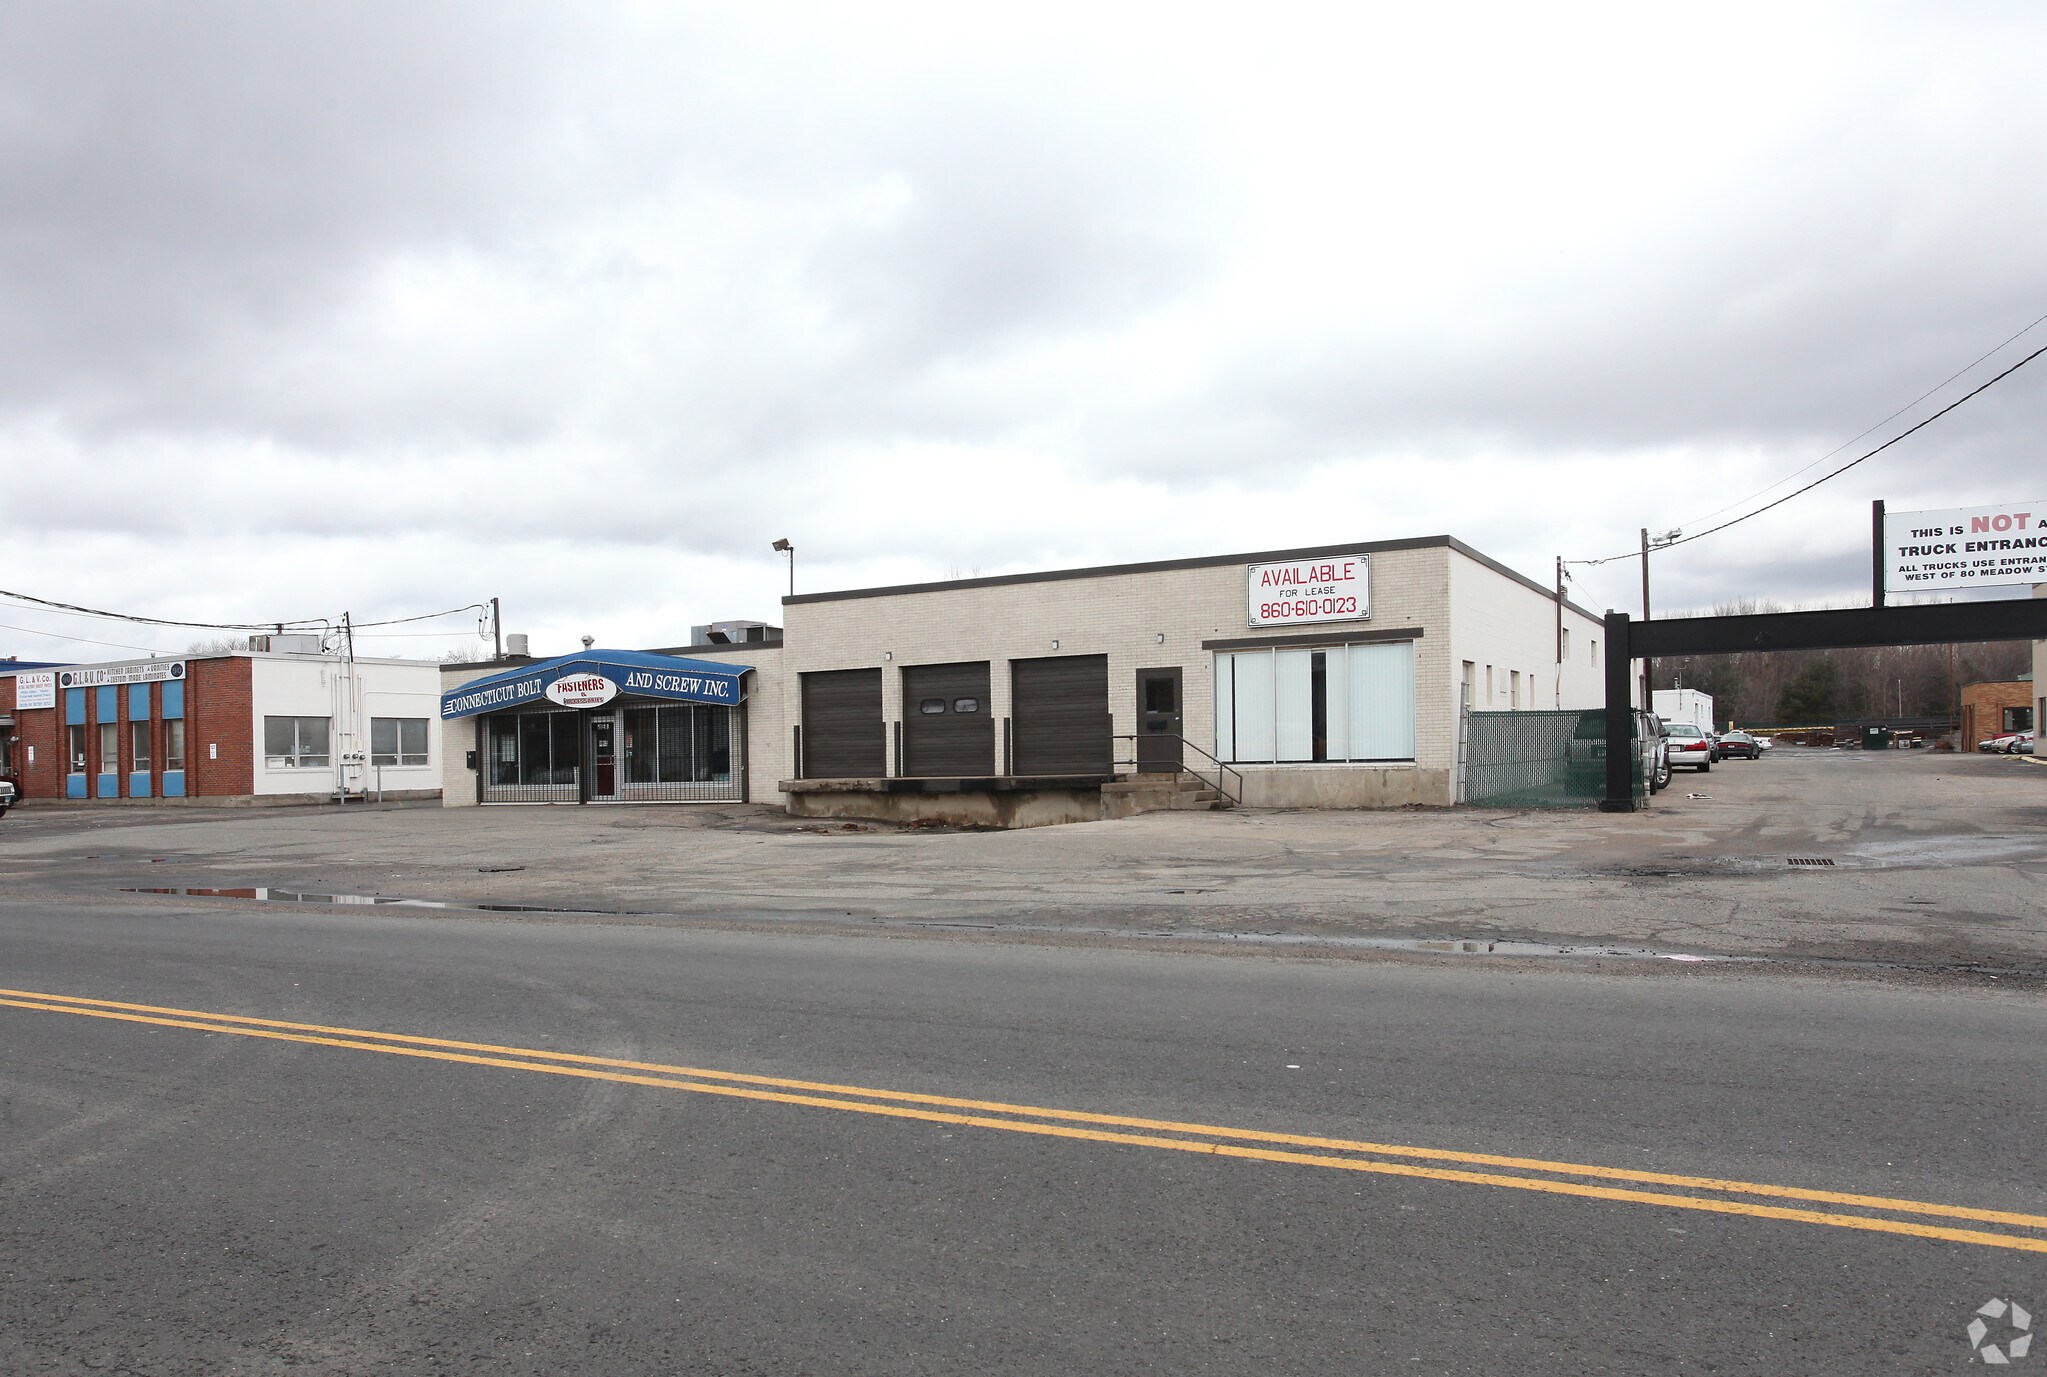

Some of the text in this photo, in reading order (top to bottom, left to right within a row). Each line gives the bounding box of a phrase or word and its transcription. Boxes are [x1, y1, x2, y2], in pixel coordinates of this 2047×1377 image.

[1910, 512, 2047, 538] THIS IS NOT A
[1898, 543, 1957, 557] TRUCK
[1898, 556, 2047, 573] ALL TRUCKS USE ENTRAN
[1260, 562, 1356, 588] AVAILABLE
[1905, 572, 1936, 581] WEST
[1940, 571, 1956, 579] OF
[1960, 570, 1975, 578] 80
[1980, 566, 2033, 577] MEADOW
[1279, 585, 1336, 598] FOR LEASE
[557, 678, 605, 694] FASTENERS
[625, 671, 729, 698] AND SCREW INC.
[450, 678, 542, 713] CONNECTICUT BOLT
